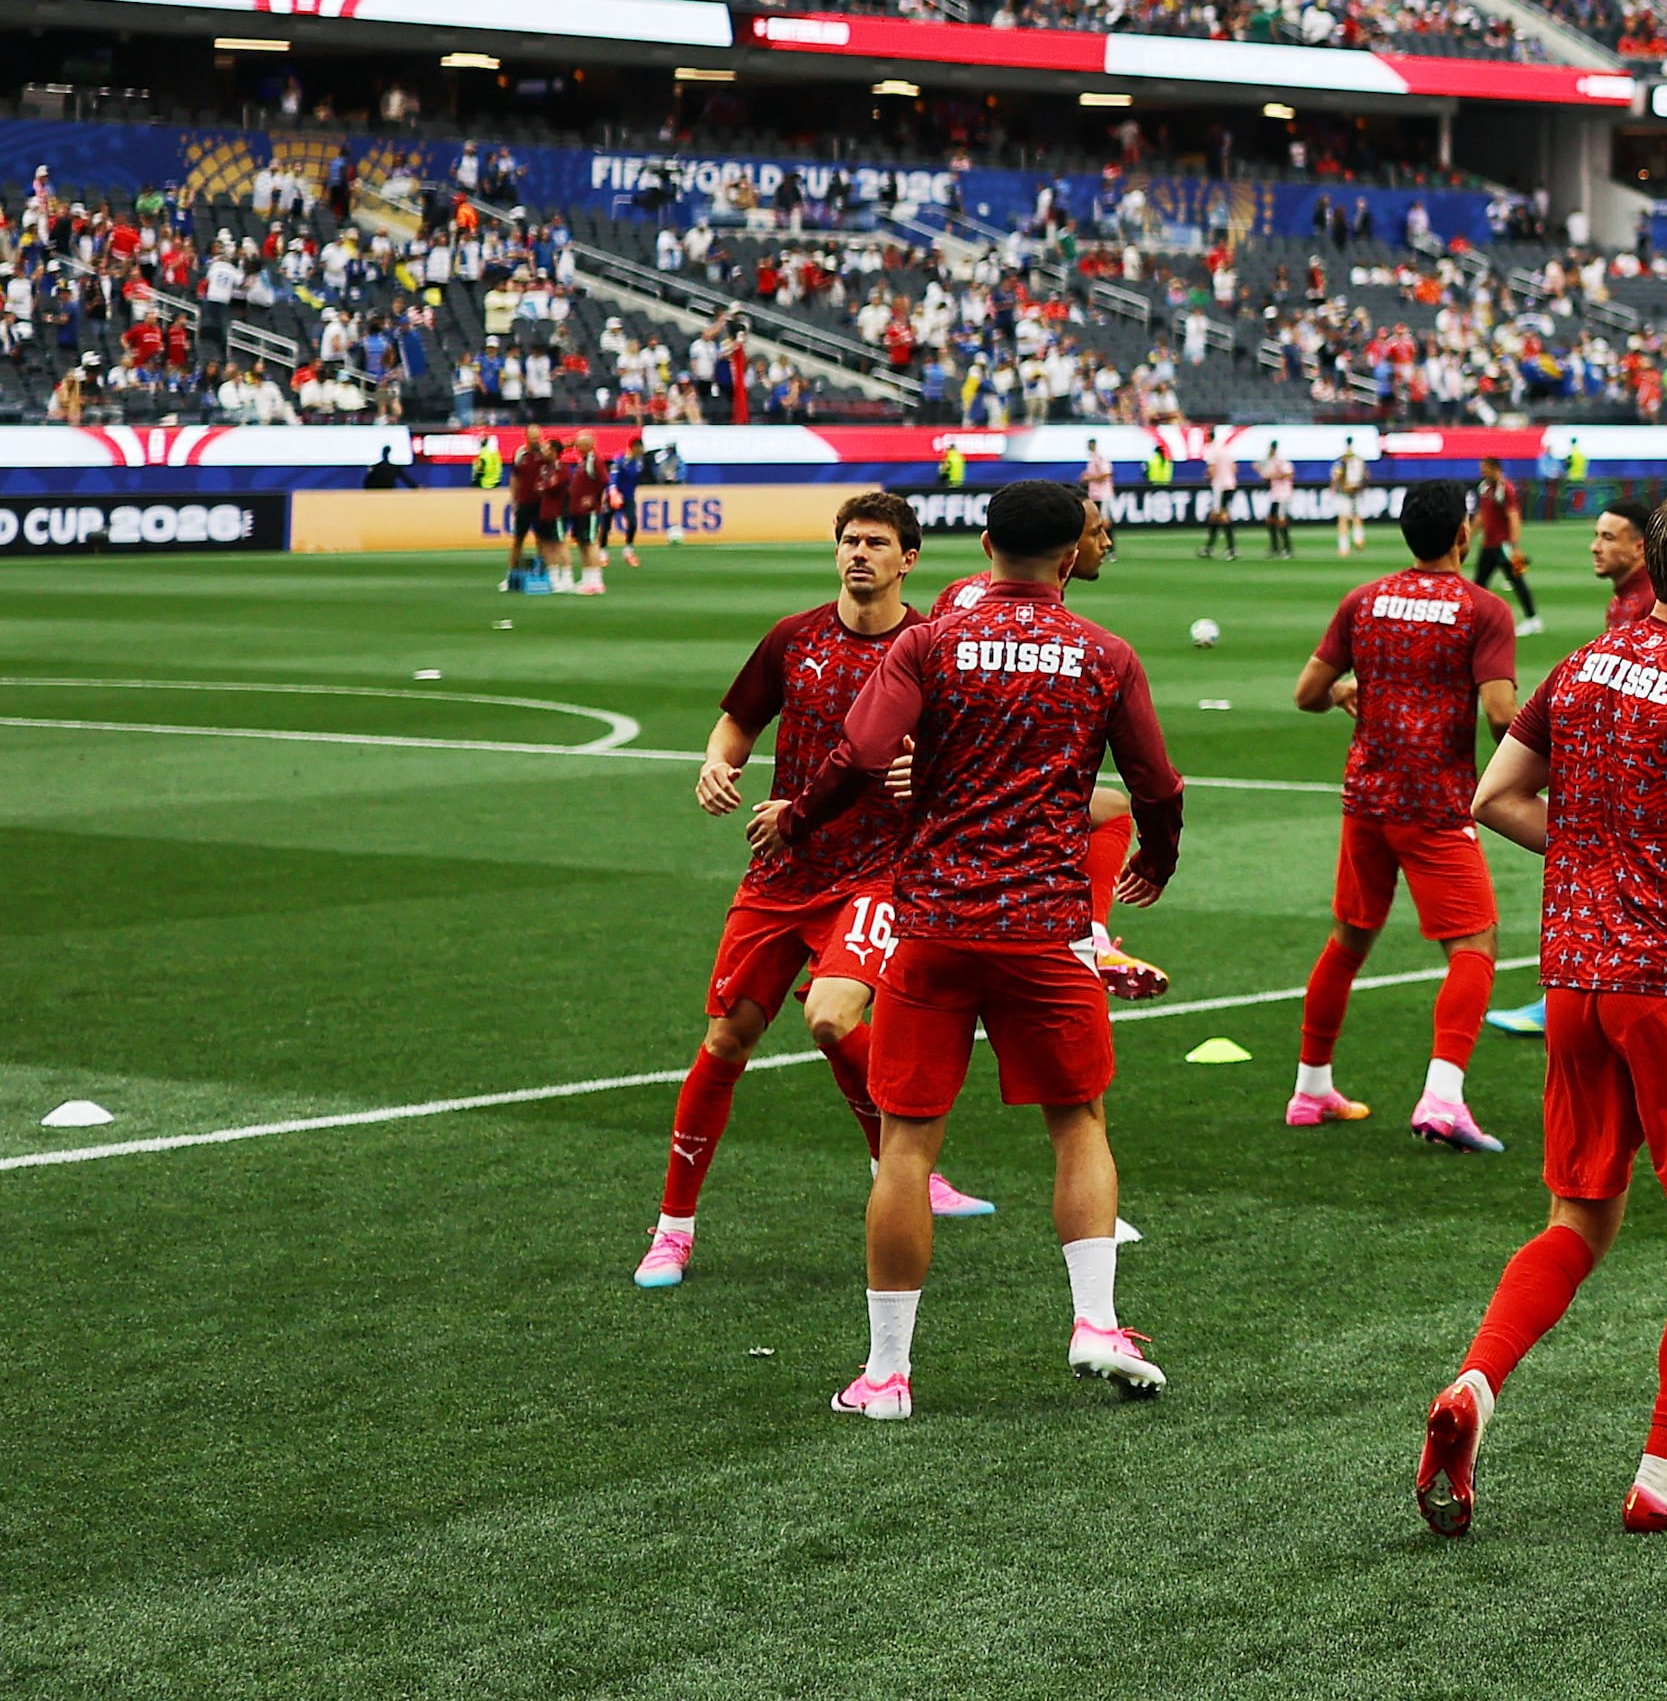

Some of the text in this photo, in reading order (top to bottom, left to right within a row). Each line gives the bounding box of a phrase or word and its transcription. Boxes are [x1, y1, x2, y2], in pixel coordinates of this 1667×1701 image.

[23, 506, 104, 545] CUP
[108, 503, 242, 544] 2026
[1372, 595, 1461, 625] SUISSE
[956, 640, 1085, 679] SUISSE
[844, 895, 896, 950] 16
